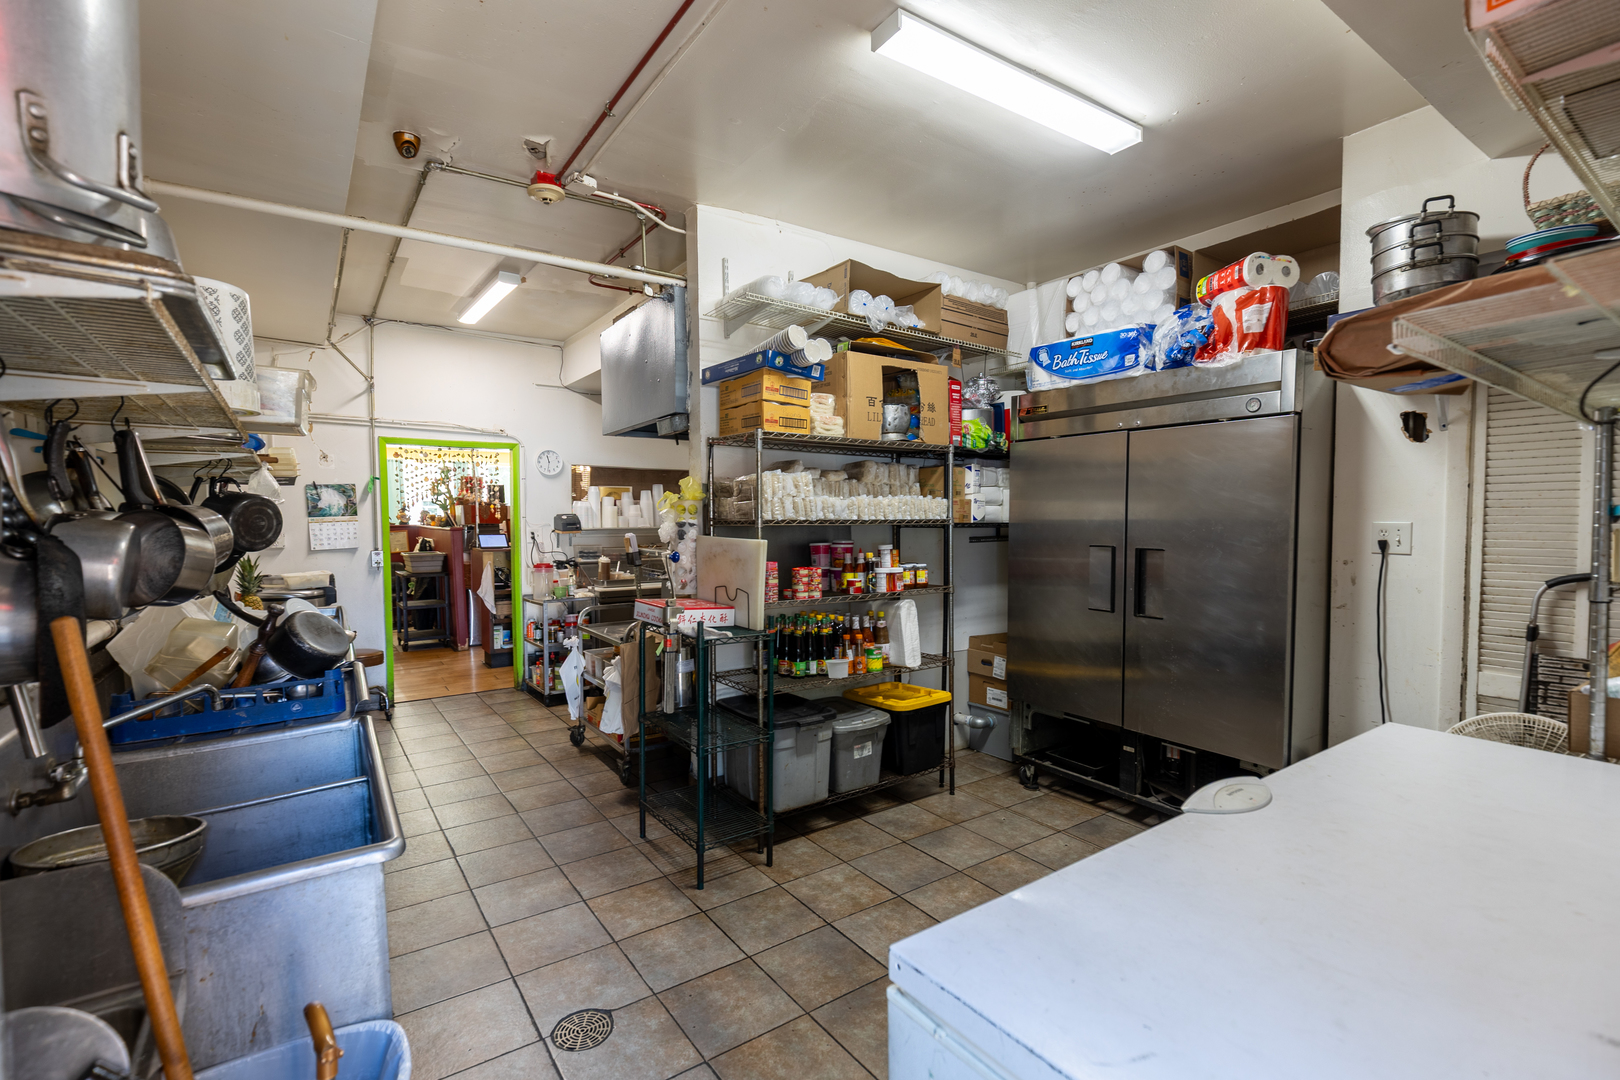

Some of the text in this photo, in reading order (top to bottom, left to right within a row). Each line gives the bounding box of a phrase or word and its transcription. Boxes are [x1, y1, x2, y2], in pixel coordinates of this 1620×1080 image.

[1071, 338, 1093, 346] KIRKLAND
[1052, 349, 1108, 370] Bath Tissue
